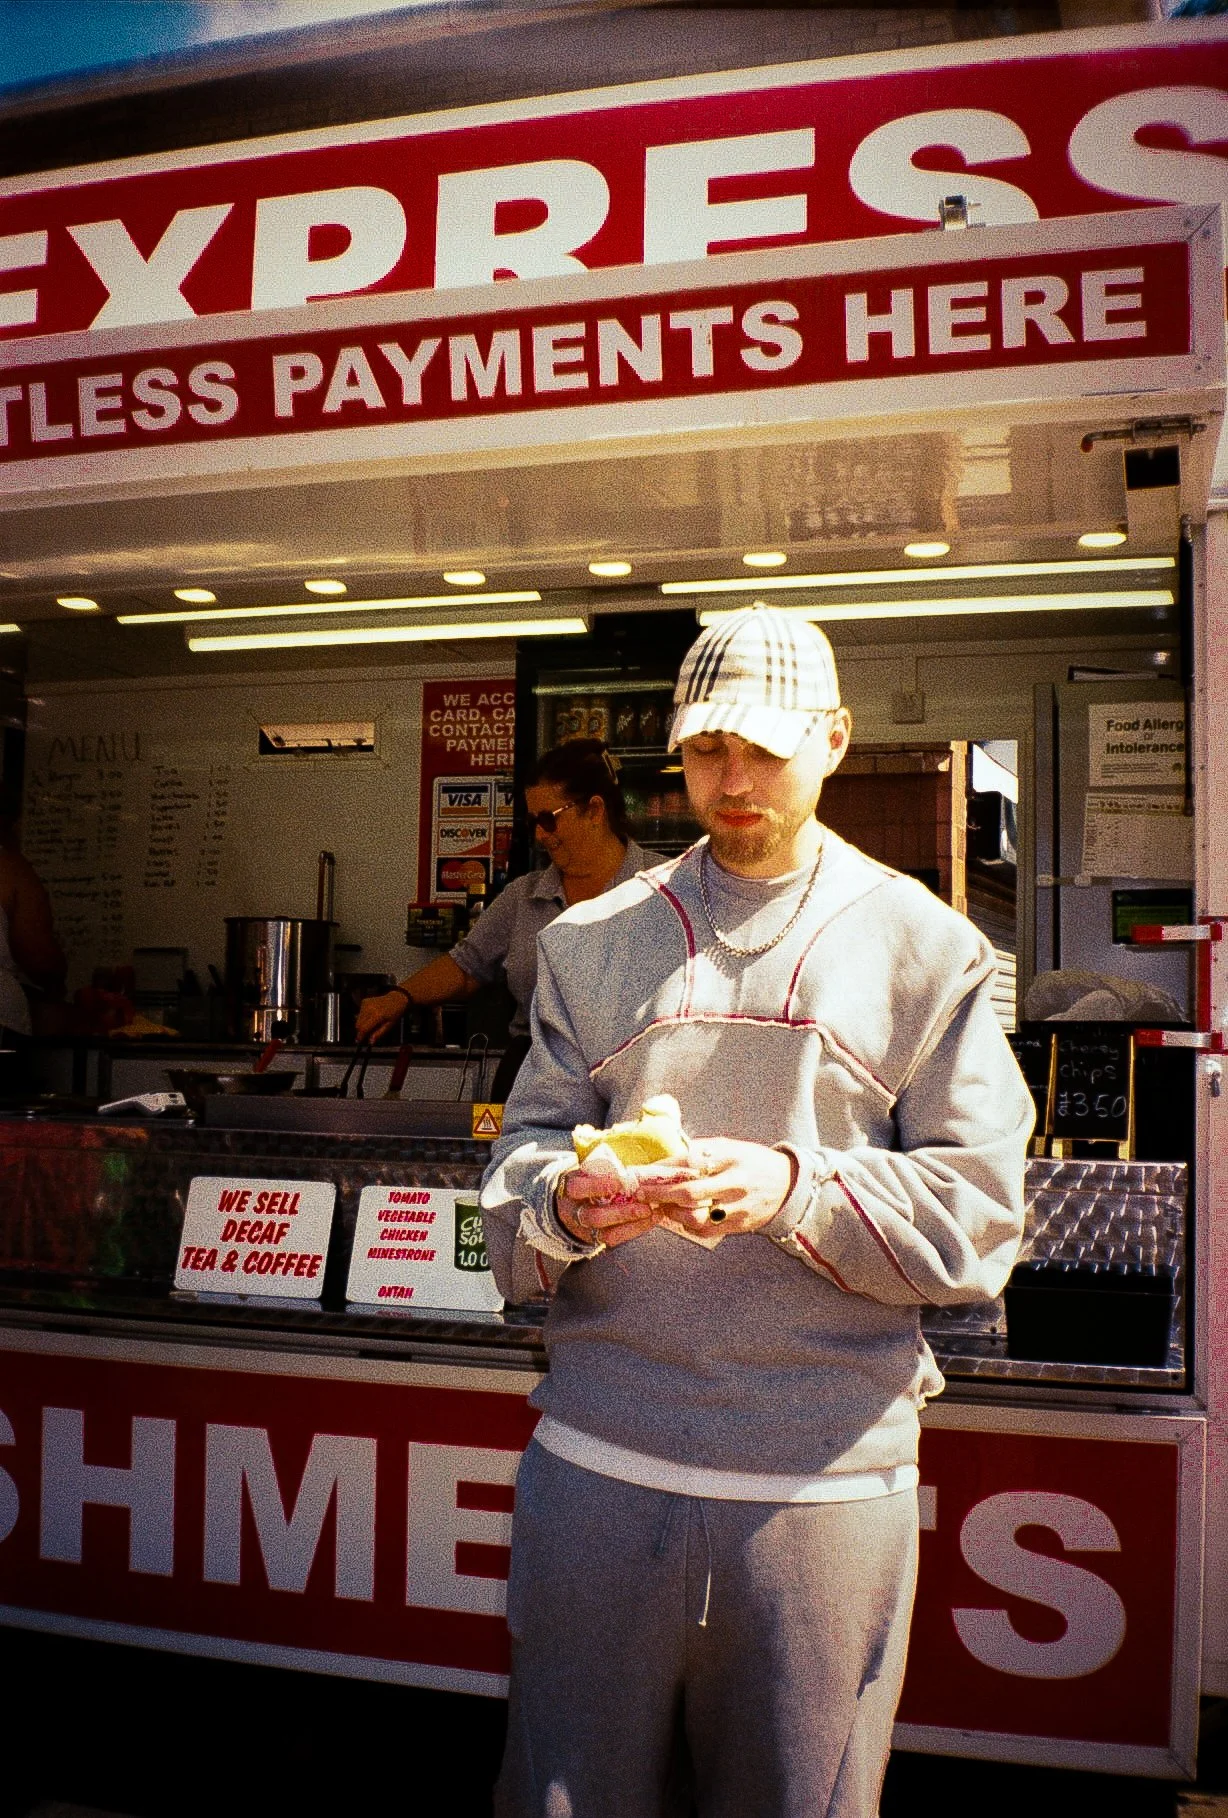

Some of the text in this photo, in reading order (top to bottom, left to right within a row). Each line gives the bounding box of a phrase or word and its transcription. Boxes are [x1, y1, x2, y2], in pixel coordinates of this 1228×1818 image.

[272, 301, 803, 419] PAYMENTS
[845, 266, 1147, 363] HERE
[443, 692, 515, 706] WE ACC
[430, 708, 486, 723] CARD,
[1106, 719, 1140, 732] Food
[50, 732, 142, 762] MENU
[1106, 742, 1185, 754] Intolerance
[448, 793, 482, 806] VISA
[440, 829, 488, 838] DISCOVER
[218, 1190, 300, 1216] WE SELL
[389, 1191, 431, 1204] TOMATO
[378, 1209, 436, 1224] VEGETABLE
[220, 1219, 290, 1245] DECAF
[380, 1228, 428, 1242] CHICKEN
[367, 1247, 436, 1261] MINESTRONE
[181, 1246, 323, 1278] TEA & COFFEE
